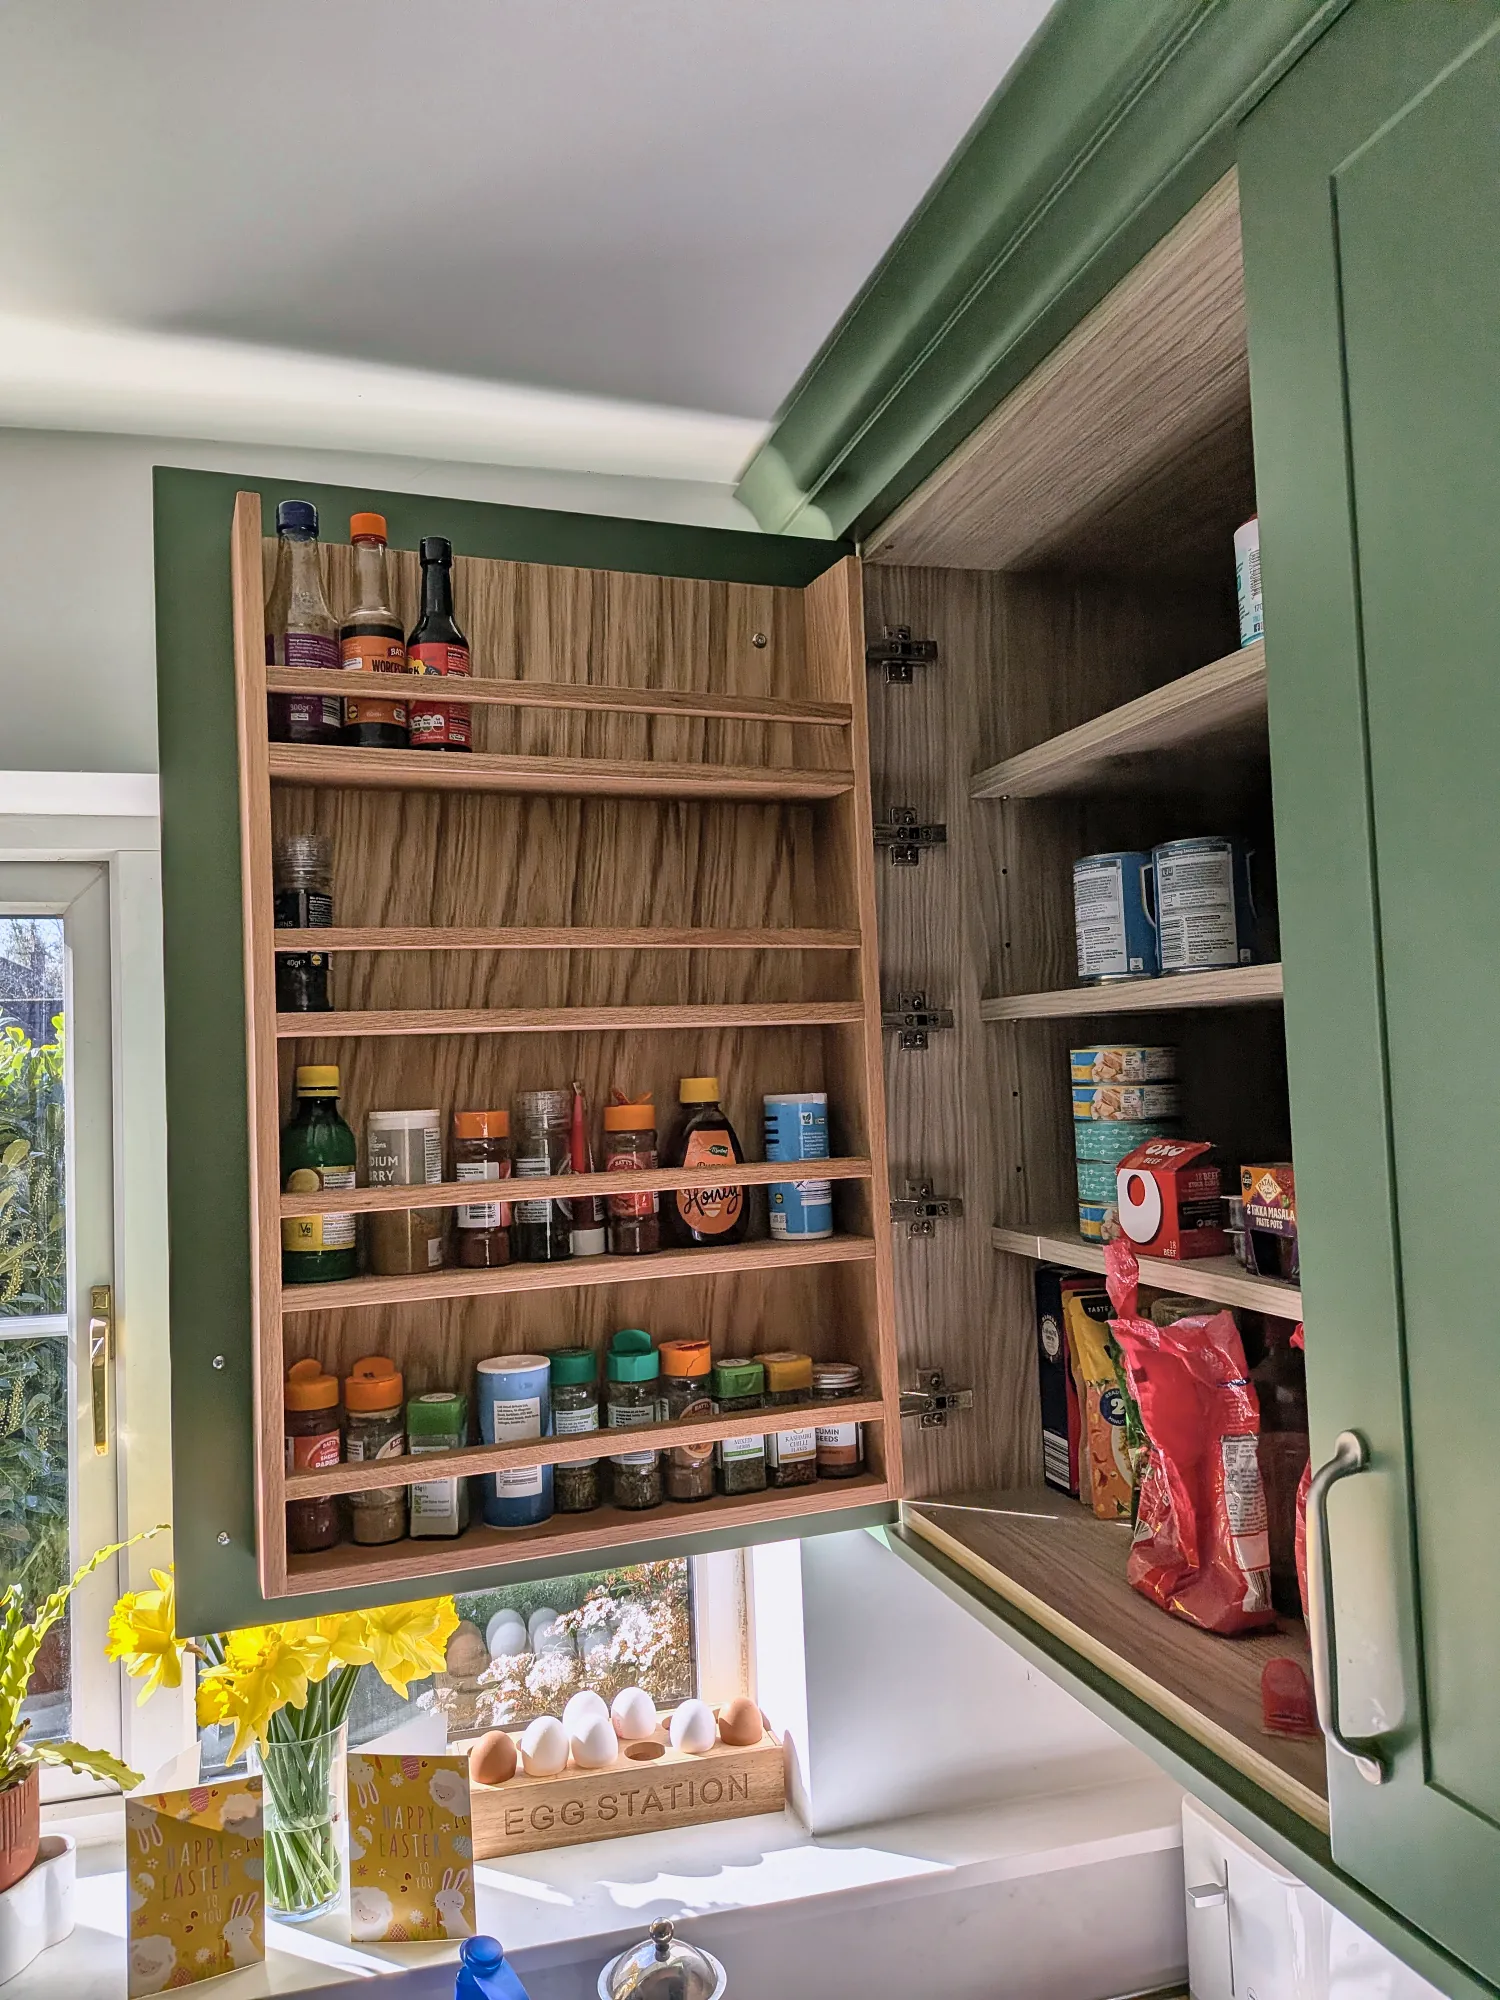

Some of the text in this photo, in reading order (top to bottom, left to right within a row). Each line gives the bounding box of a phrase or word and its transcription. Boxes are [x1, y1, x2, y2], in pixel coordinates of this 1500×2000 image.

[1145, 1144, 1186, 1157] OXO
[369, 1155, 399, 1167] DIUM
[1143, 1157, 1162, 1165] BEEF
[684, 1185, 741, 1216] Honey
[1246, 1203, 1296, 1222] 2 TIKKA MASALA
[1255, 1216, 1284, 1230] PASTE POTS
[1169, 1240, 1177, 1250] 18
[1163, 1248, 1177, 1257] BEEF
[1110, 1397, 1126, 1415] 2
[815, 1427, 840, 1436] CUMIN
[815, 1435, 839, 1443] SEEDS
[503, 1772, 749, 1836] EGG STATION
[381, 1805, 435, 1830] HAPPY
[379, 1833, 441, 1858] EASTER
[167, 1836, 224, 1870] HAPPY
[419, 1861, 430, 1875] TO
[162, 1862, 231, 1901] EASTER
[415, 1876, 434, 1890] YOU
[205, 1894, 218, 1909] TO
[202, 1908, 222, 1925] YOU
